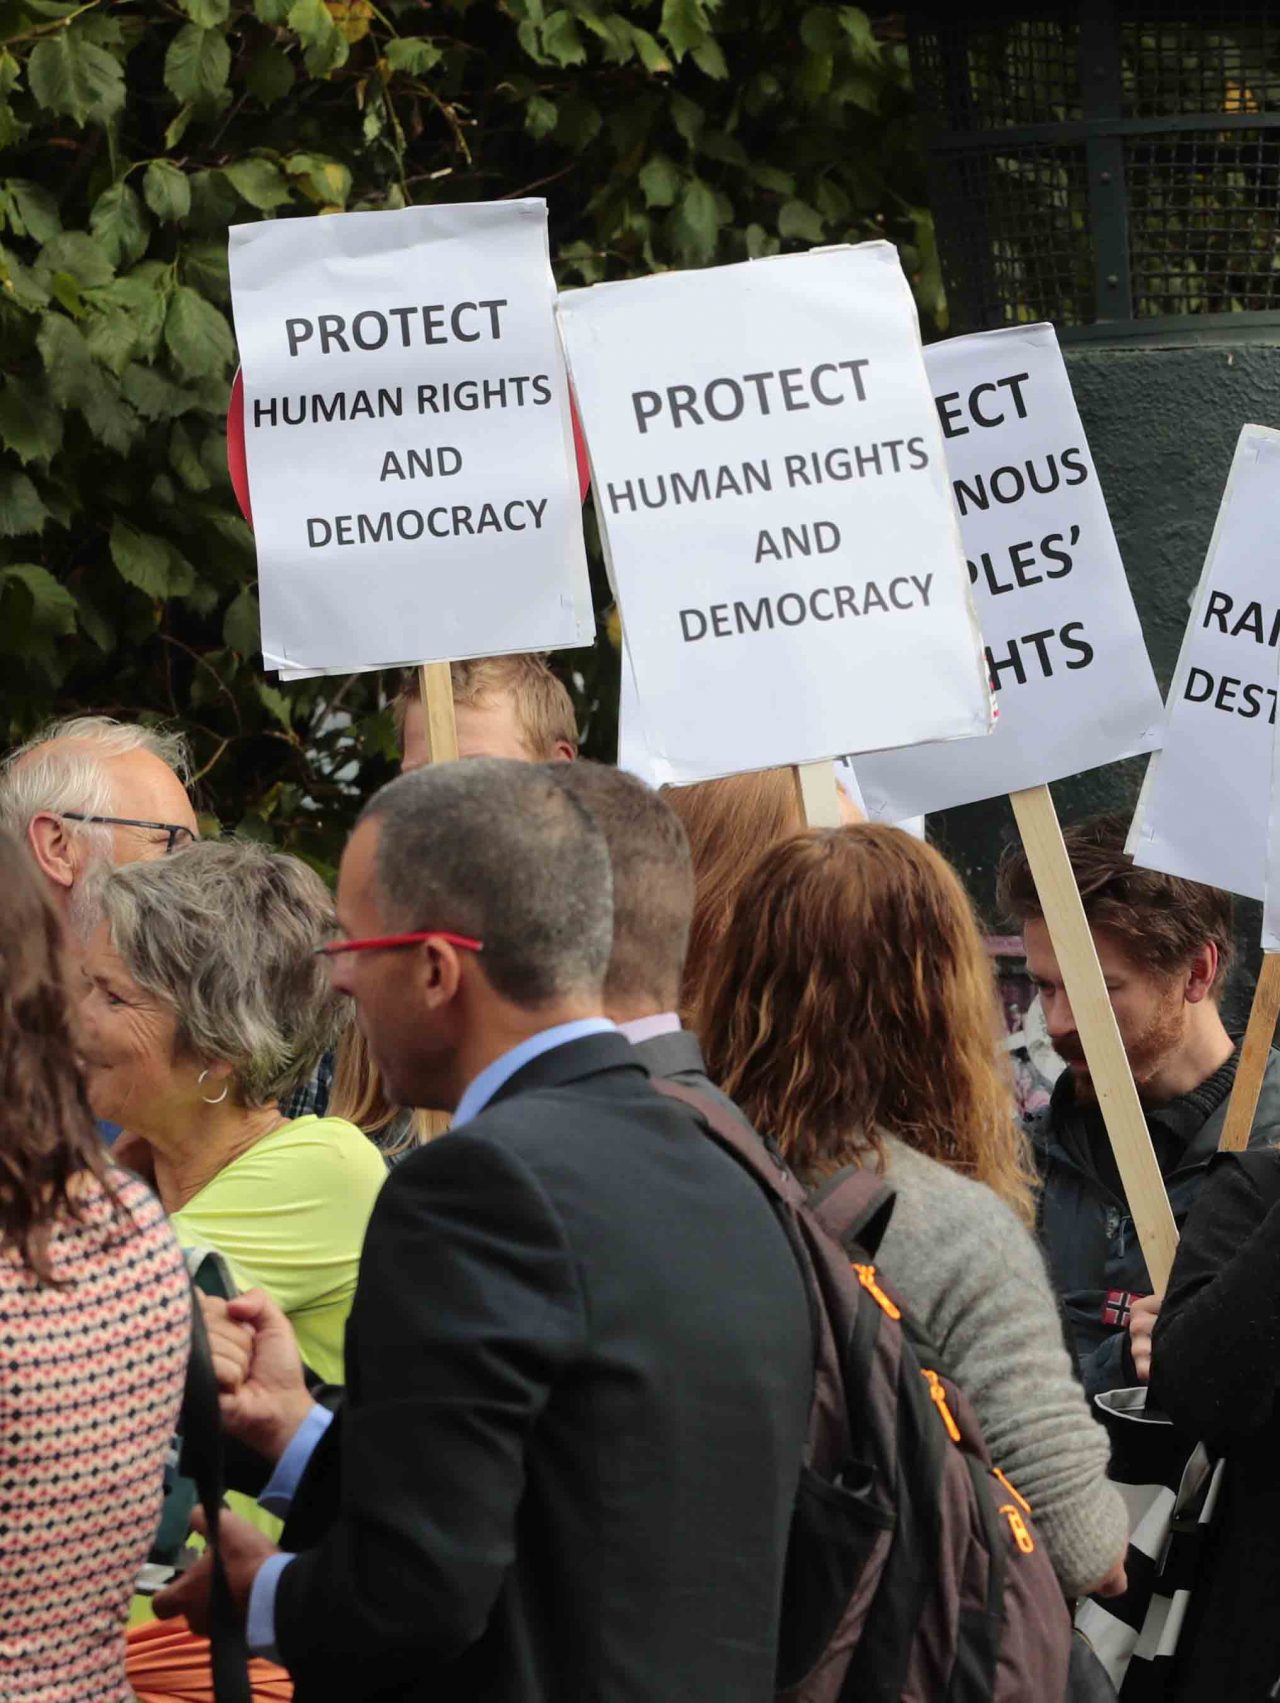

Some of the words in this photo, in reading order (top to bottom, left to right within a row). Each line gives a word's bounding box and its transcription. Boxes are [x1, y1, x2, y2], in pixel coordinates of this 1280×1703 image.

[286, 300, 507, 356] PROTECT
[254, 387, 402, 427] HUMAN
[418, 375, 551, 414] RIGHTS
[632, 359, 869, 434] PROTECT
[380, 447, 462, 481] AND
[607, 459, 772, 514] HUMAN
[785, 437, 928, 487] RIGHTS
[307, 499, 547, 547] DEMOCRACY
[755, 521, 840, 563] AND
[679, 573, 932, 642] DEMOCRACY
